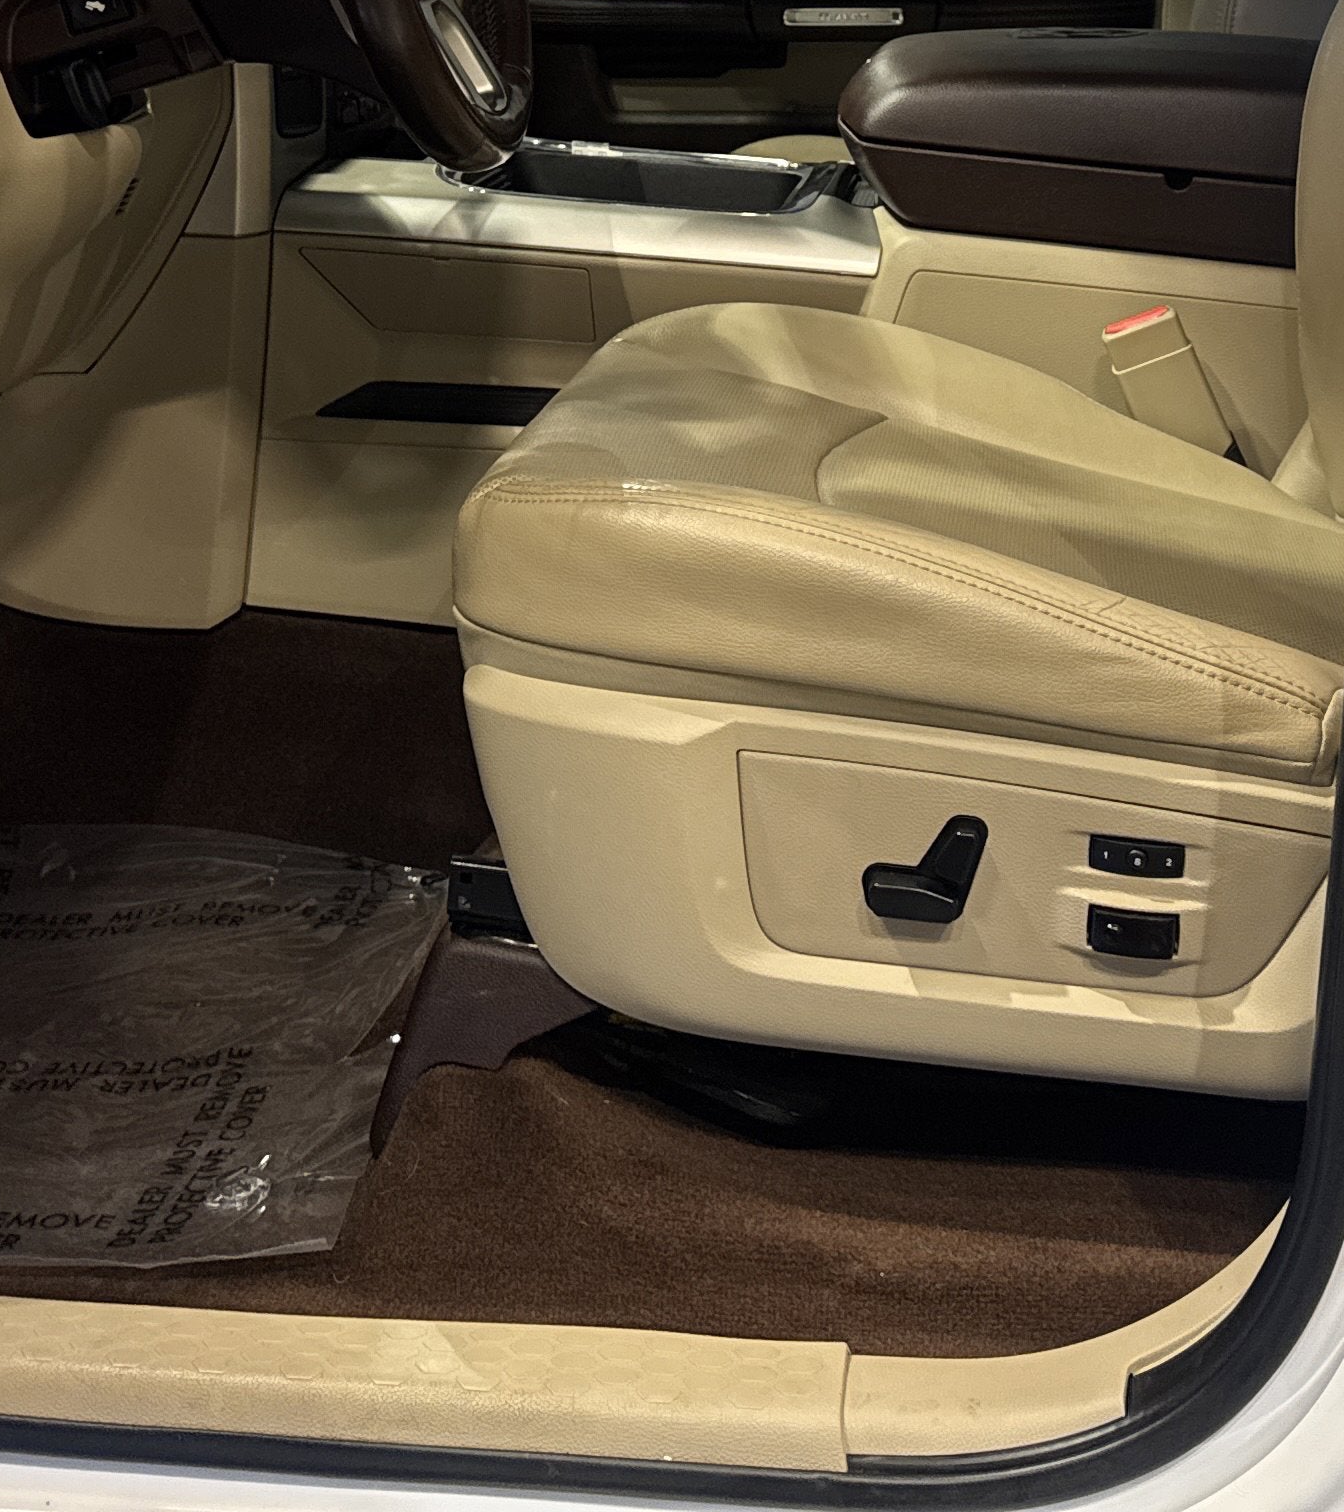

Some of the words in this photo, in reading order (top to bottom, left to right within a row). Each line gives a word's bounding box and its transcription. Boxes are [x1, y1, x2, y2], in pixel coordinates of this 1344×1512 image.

[151, 911, 246, 928] COVER
[42, 1048, 223, 1077] PROTECTIVE
[98, 1071, 213, 1097] DEALER
[218, 1084, 270, 1142] COVER
[106, 1184, 172, 1250] DEALER
[160, 1129, 210, 1178] MUST
[194, 1045, 255, 1123] REMOVE
